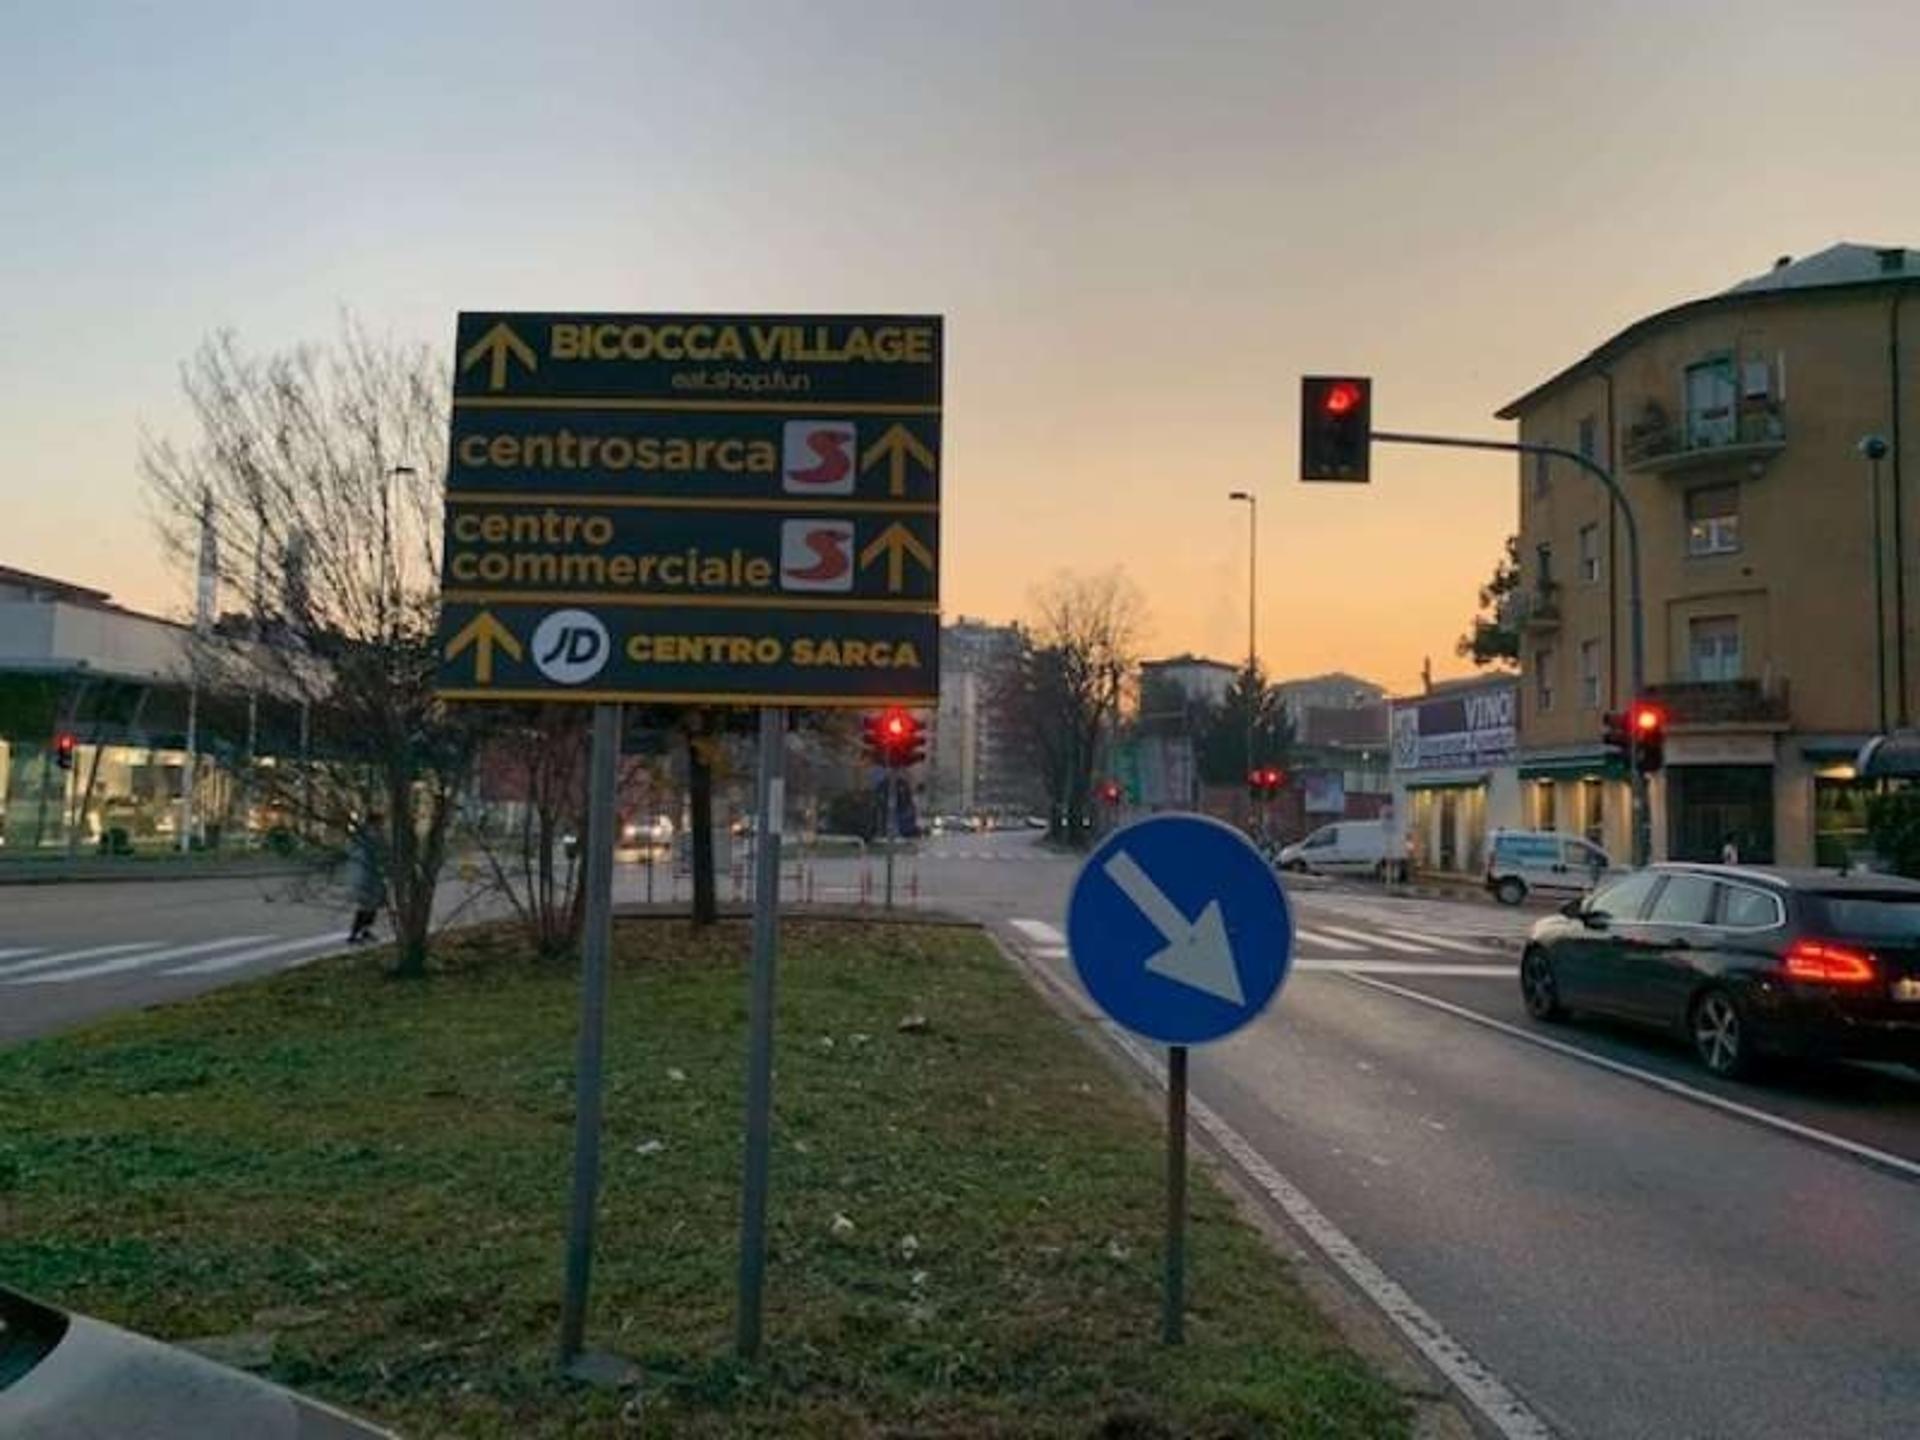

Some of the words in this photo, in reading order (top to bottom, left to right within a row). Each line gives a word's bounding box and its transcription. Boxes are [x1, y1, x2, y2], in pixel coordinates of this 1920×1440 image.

[551, 323, 746, 361] BICOCCA
[749, 325, 933, 363] VILLAGE
[458, 427, 776, 473] centrosarca
[453, 508, 614, 546] centro
[452, 547, 774, 588] commerciale
[626, 633, 783, 665] CENTRO
[791, 639, 922, 669] SARCA
